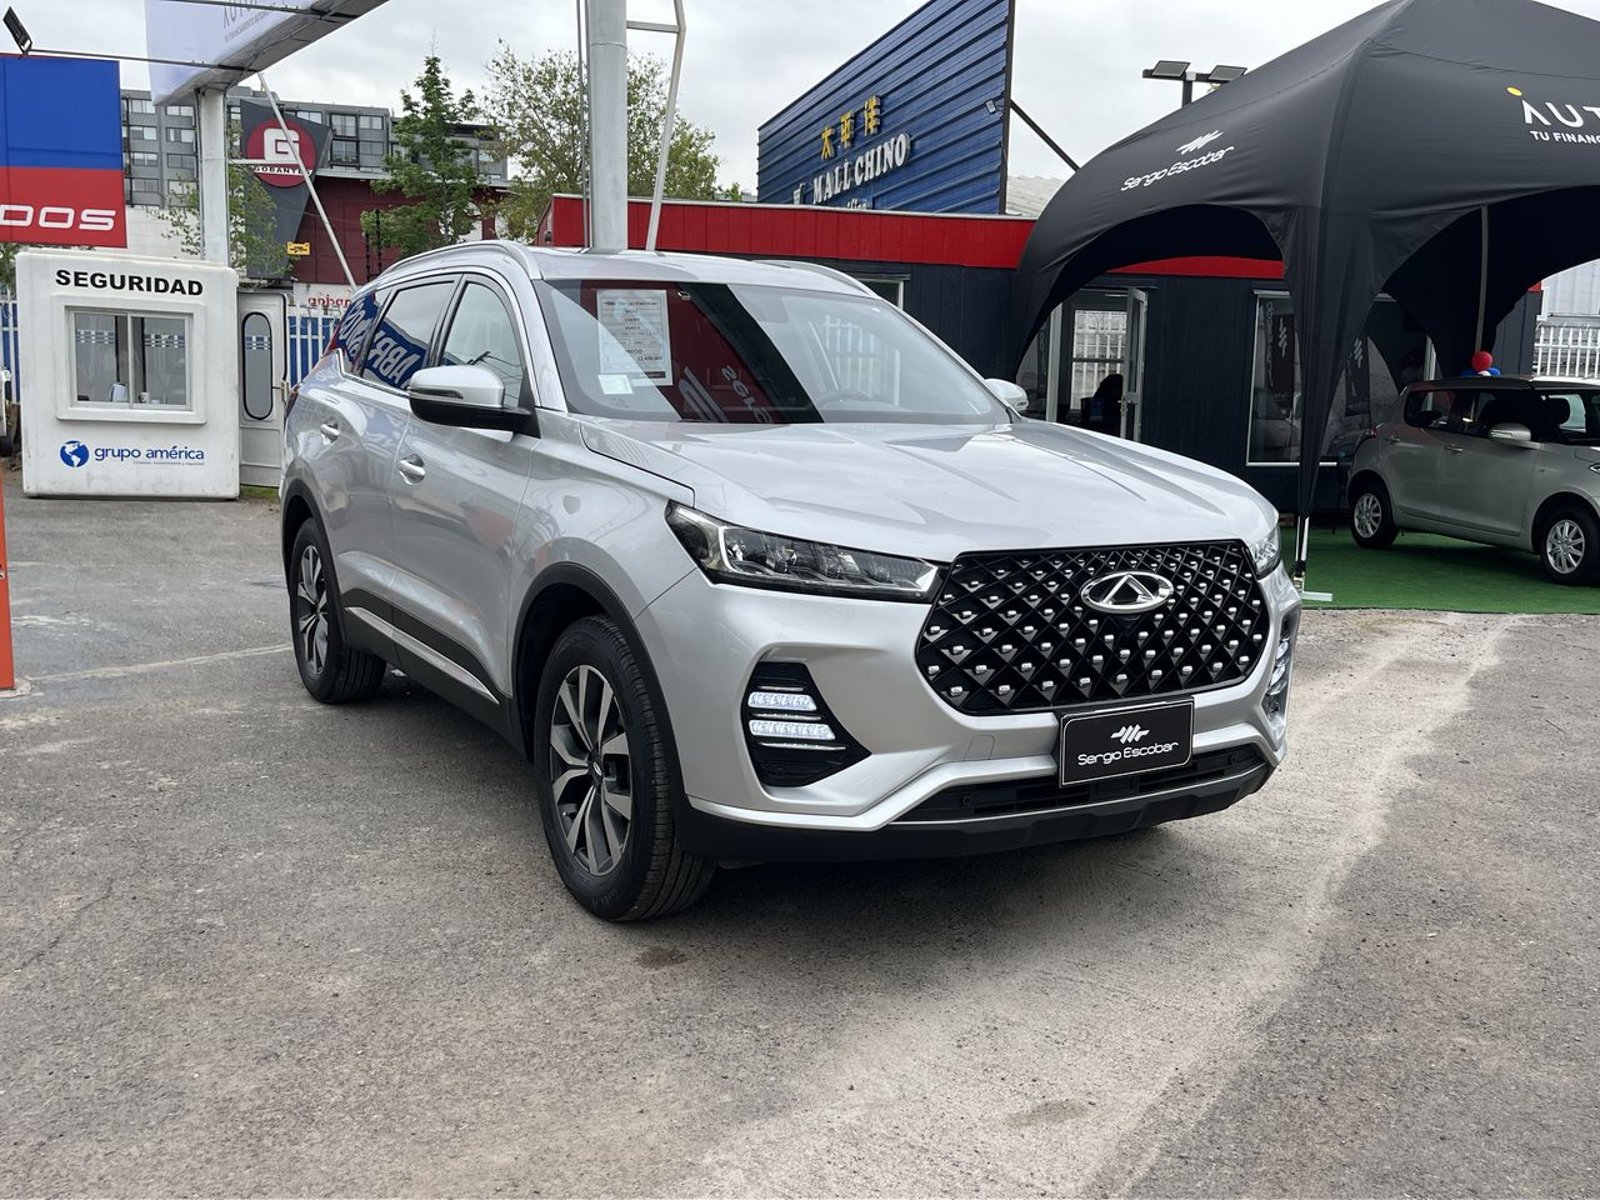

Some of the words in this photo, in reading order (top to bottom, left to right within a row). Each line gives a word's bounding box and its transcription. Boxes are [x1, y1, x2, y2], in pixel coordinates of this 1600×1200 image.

[264, 128, 299, 165] G
[1530, 130, 1550, 141] TU
[813, 161, 851, 204] MALL
[854, 133, 908, 186] CHINO
[1120, 168, 1167, 191] Sergo
[1167, 146, 1234, 176] Escobar
[0, 204, 116, 231] DOS
[55, 269, 204, 296] SEGURIDAD
[94, 447, 142, 461] grupo
[145, 445, 205, 460] américa
[1077, 750, 1123, 766] Sergo
[1123, 741, 1180, 759] Escobar
